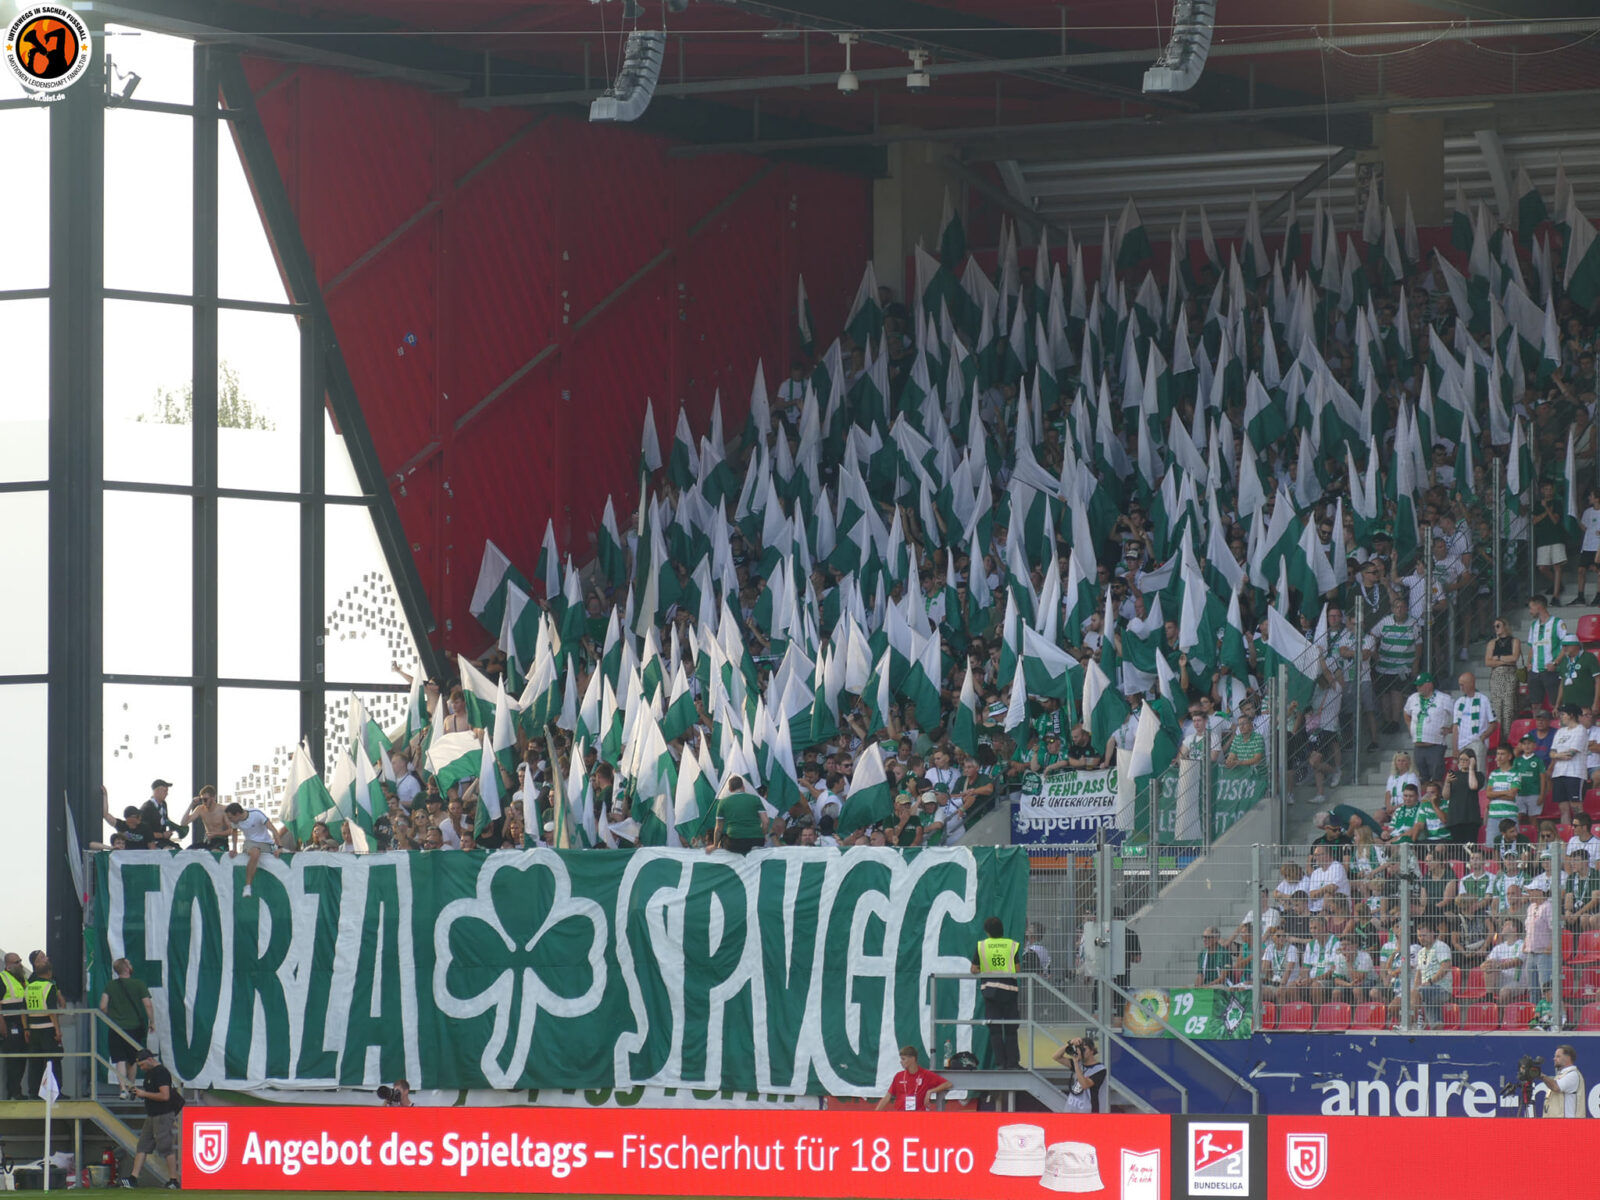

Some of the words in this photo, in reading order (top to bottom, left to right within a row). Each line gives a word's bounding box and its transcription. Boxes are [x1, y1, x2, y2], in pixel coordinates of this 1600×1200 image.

[1048, 778, 1105, 796] FEHLPASS
[1031, 796, 1045, 808] DIE
[1017, 815, 1118, 837] Superma
[116, 856, 413, 1085] FORZA
[622, 854, 974, 1089] SPVGG
[991, 957, 1006, 967] 833
[1173, 992, 1194, 1016] 19
[1184, 1016, 1208, 1035] 03
[241, 1131, 372, 1176] Angebot
[379, 1131, 433, 1167] des
[442, 1132, 588, 1178] Spieltags
[622, 1134, 785, 1171] Fischerhut
[795, 1135, 840, 1171] für
[851, 1138, 891, 1172] 18
[903, 1138, 974, 1174] Euro
[1227, 1152, 1241, 1175] 2
[1194, 1181, 1244, 1190] BUNDESLIGA
